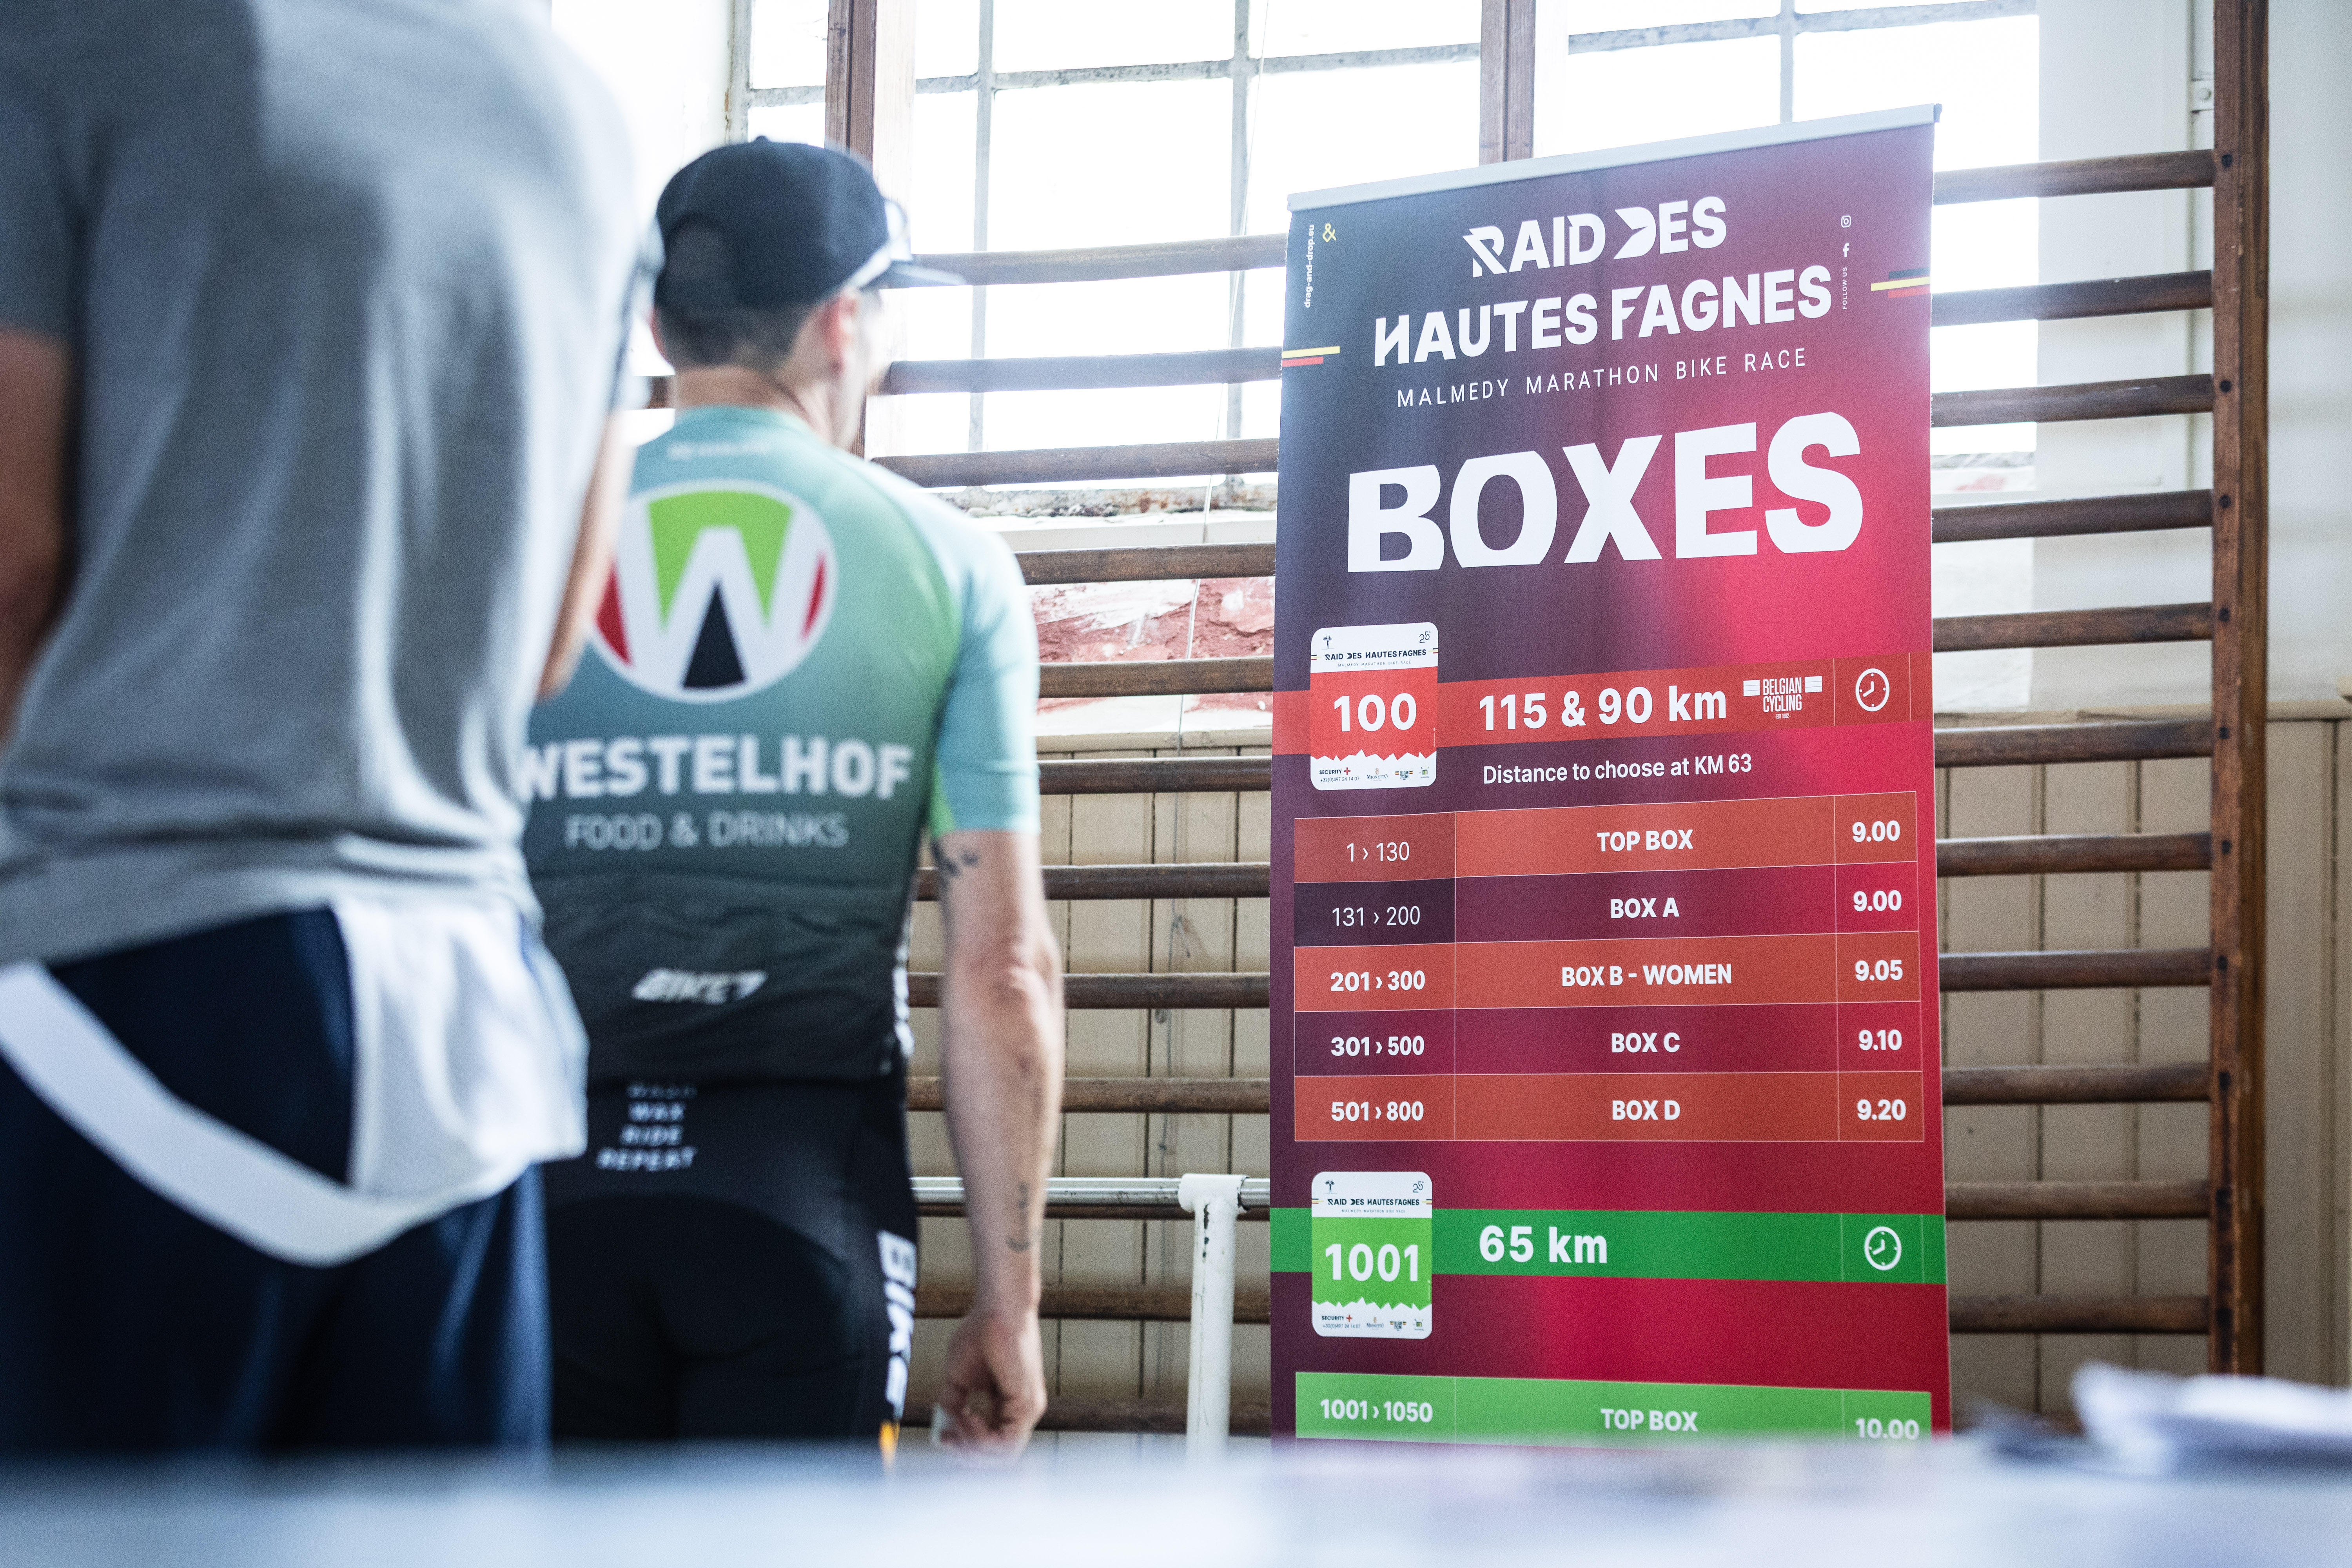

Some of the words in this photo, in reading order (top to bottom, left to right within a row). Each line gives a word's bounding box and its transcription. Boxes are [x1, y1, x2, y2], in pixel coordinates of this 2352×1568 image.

[1463, 213, 1606, 278] RAID
[1613, 196, 1727, 260] DES
[1304, 224, 1315, 308] drag-and-drop.eu
[1842, 267, 1847, 277] US
[1374, 293, 1598, 367] HAUTES
[1612, 265, 1832, 340] FAGNES
[1398, 379, 1508, 407] MALMEDY
[1526, 363, 1657, 394] MARATHON
[1676, 356, 1726, 379] BIKE
[1745, 348, 1805, 372] RACE
[1347, 412, 1863, 573] BOXES
[1399, 649, 1426, 657] FAGNES
[1763, 677, 1802, 695] BELGIAN
[1334, 693, 1417, 732] 100
[1479, 693, 1547, 731] 115
[1561, 691, 1586, 727] &
[1598, 686, 1653, 724] 90
[1669, 685, 1726, 721] km
[1763, 694, 1802, 713] CYCLING
[517, 734, 913, 800] WESTELHOF
[1484, 765, 1567, 784] Distance
[1572, 763, 1590, 780] to
[1595, 760, 1665, 779] choose
[1670, 758, 1690, 776] at
[1695, 755, 1723, 775] KM
[1728, 753, 1752, 773] 63
[564, 812, 663, 851] FOOD
[668, 812, 700, 848] &
[707, 810, 849, 848] DRINKS
[1597, 831, 1640, 852] TOP
[1646, 829, 1693, 850] BOX
[1852, 820, 1900, 842] 9.00
[1611, 898, 1657, 918] BOX
[1662, 897, 1680, 917] A
[1853, 890, 1902, 912] 9.00
[1562, 966, 1604, 987] BOX
[1610, 965, 1623, 985] B
[1642, 964, 1731, 985] WOMEN
[1855, 960, 1903, 981] 9.05
[1612, 1033, 1657, 1053] BOX
[1663, 1032, 1680, 1053] C
[1858, 1029, 1902, 1051] 9.10
[1612, 1100, 1659, 1120] BOX
[1664, 1100, 1681, 1120] D
[1857, 1099, 1906, 1120] 9.20
[597, 1147, 697, 1172] REPEAT
[1479, 1225, 1534, 1263] 65
[1549, 1226, 1607, 1263] km
[1325, 1243, 1418, 1282] 1001
[1601, 1408, 1644, 1430] TOP
[1649, 1410, 1698, 1432] BOX
[1855, 1418, 1920, 1441] 10.00
